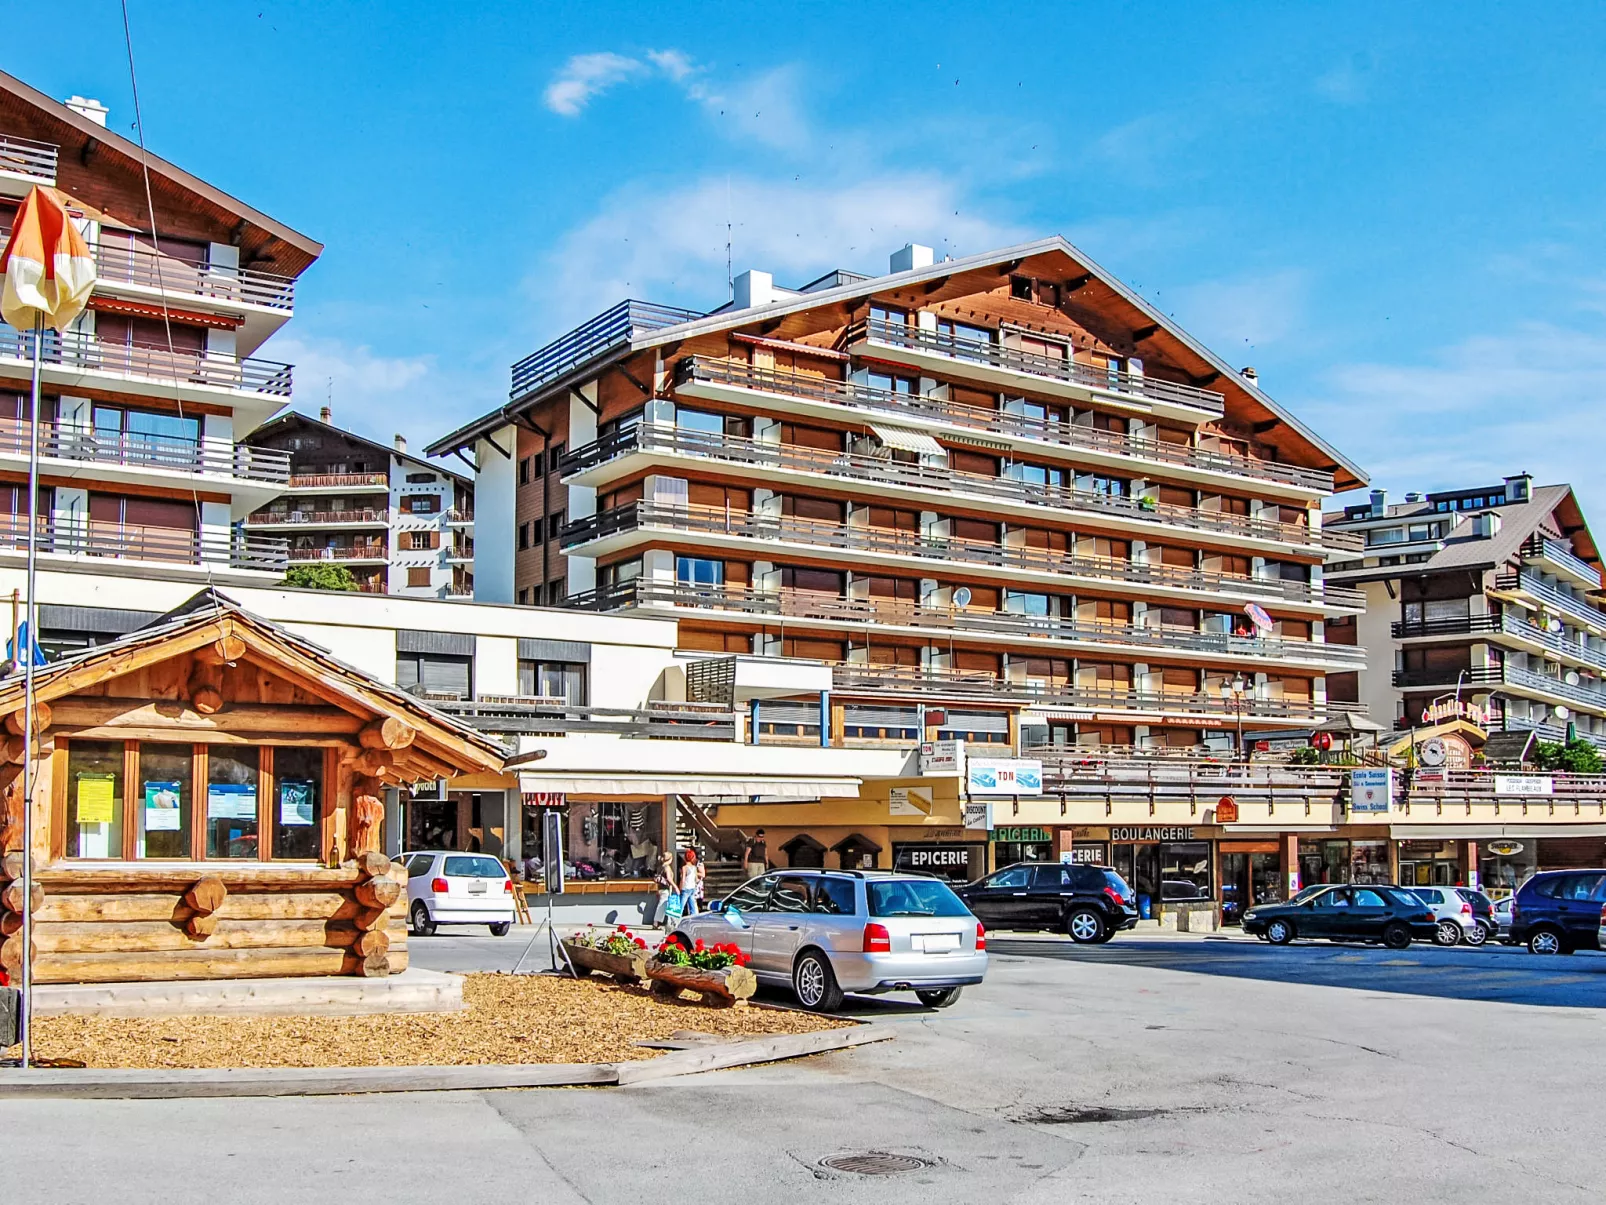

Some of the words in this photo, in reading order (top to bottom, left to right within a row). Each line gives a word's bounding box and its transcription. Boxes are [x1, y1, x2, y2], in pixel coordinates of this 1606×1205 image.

[966, 806, 987, 814] DISCOUNT
[1112, 827, 1195, 841] BOULANGERIE
[912, 851, 968, 865] EPICERIE
